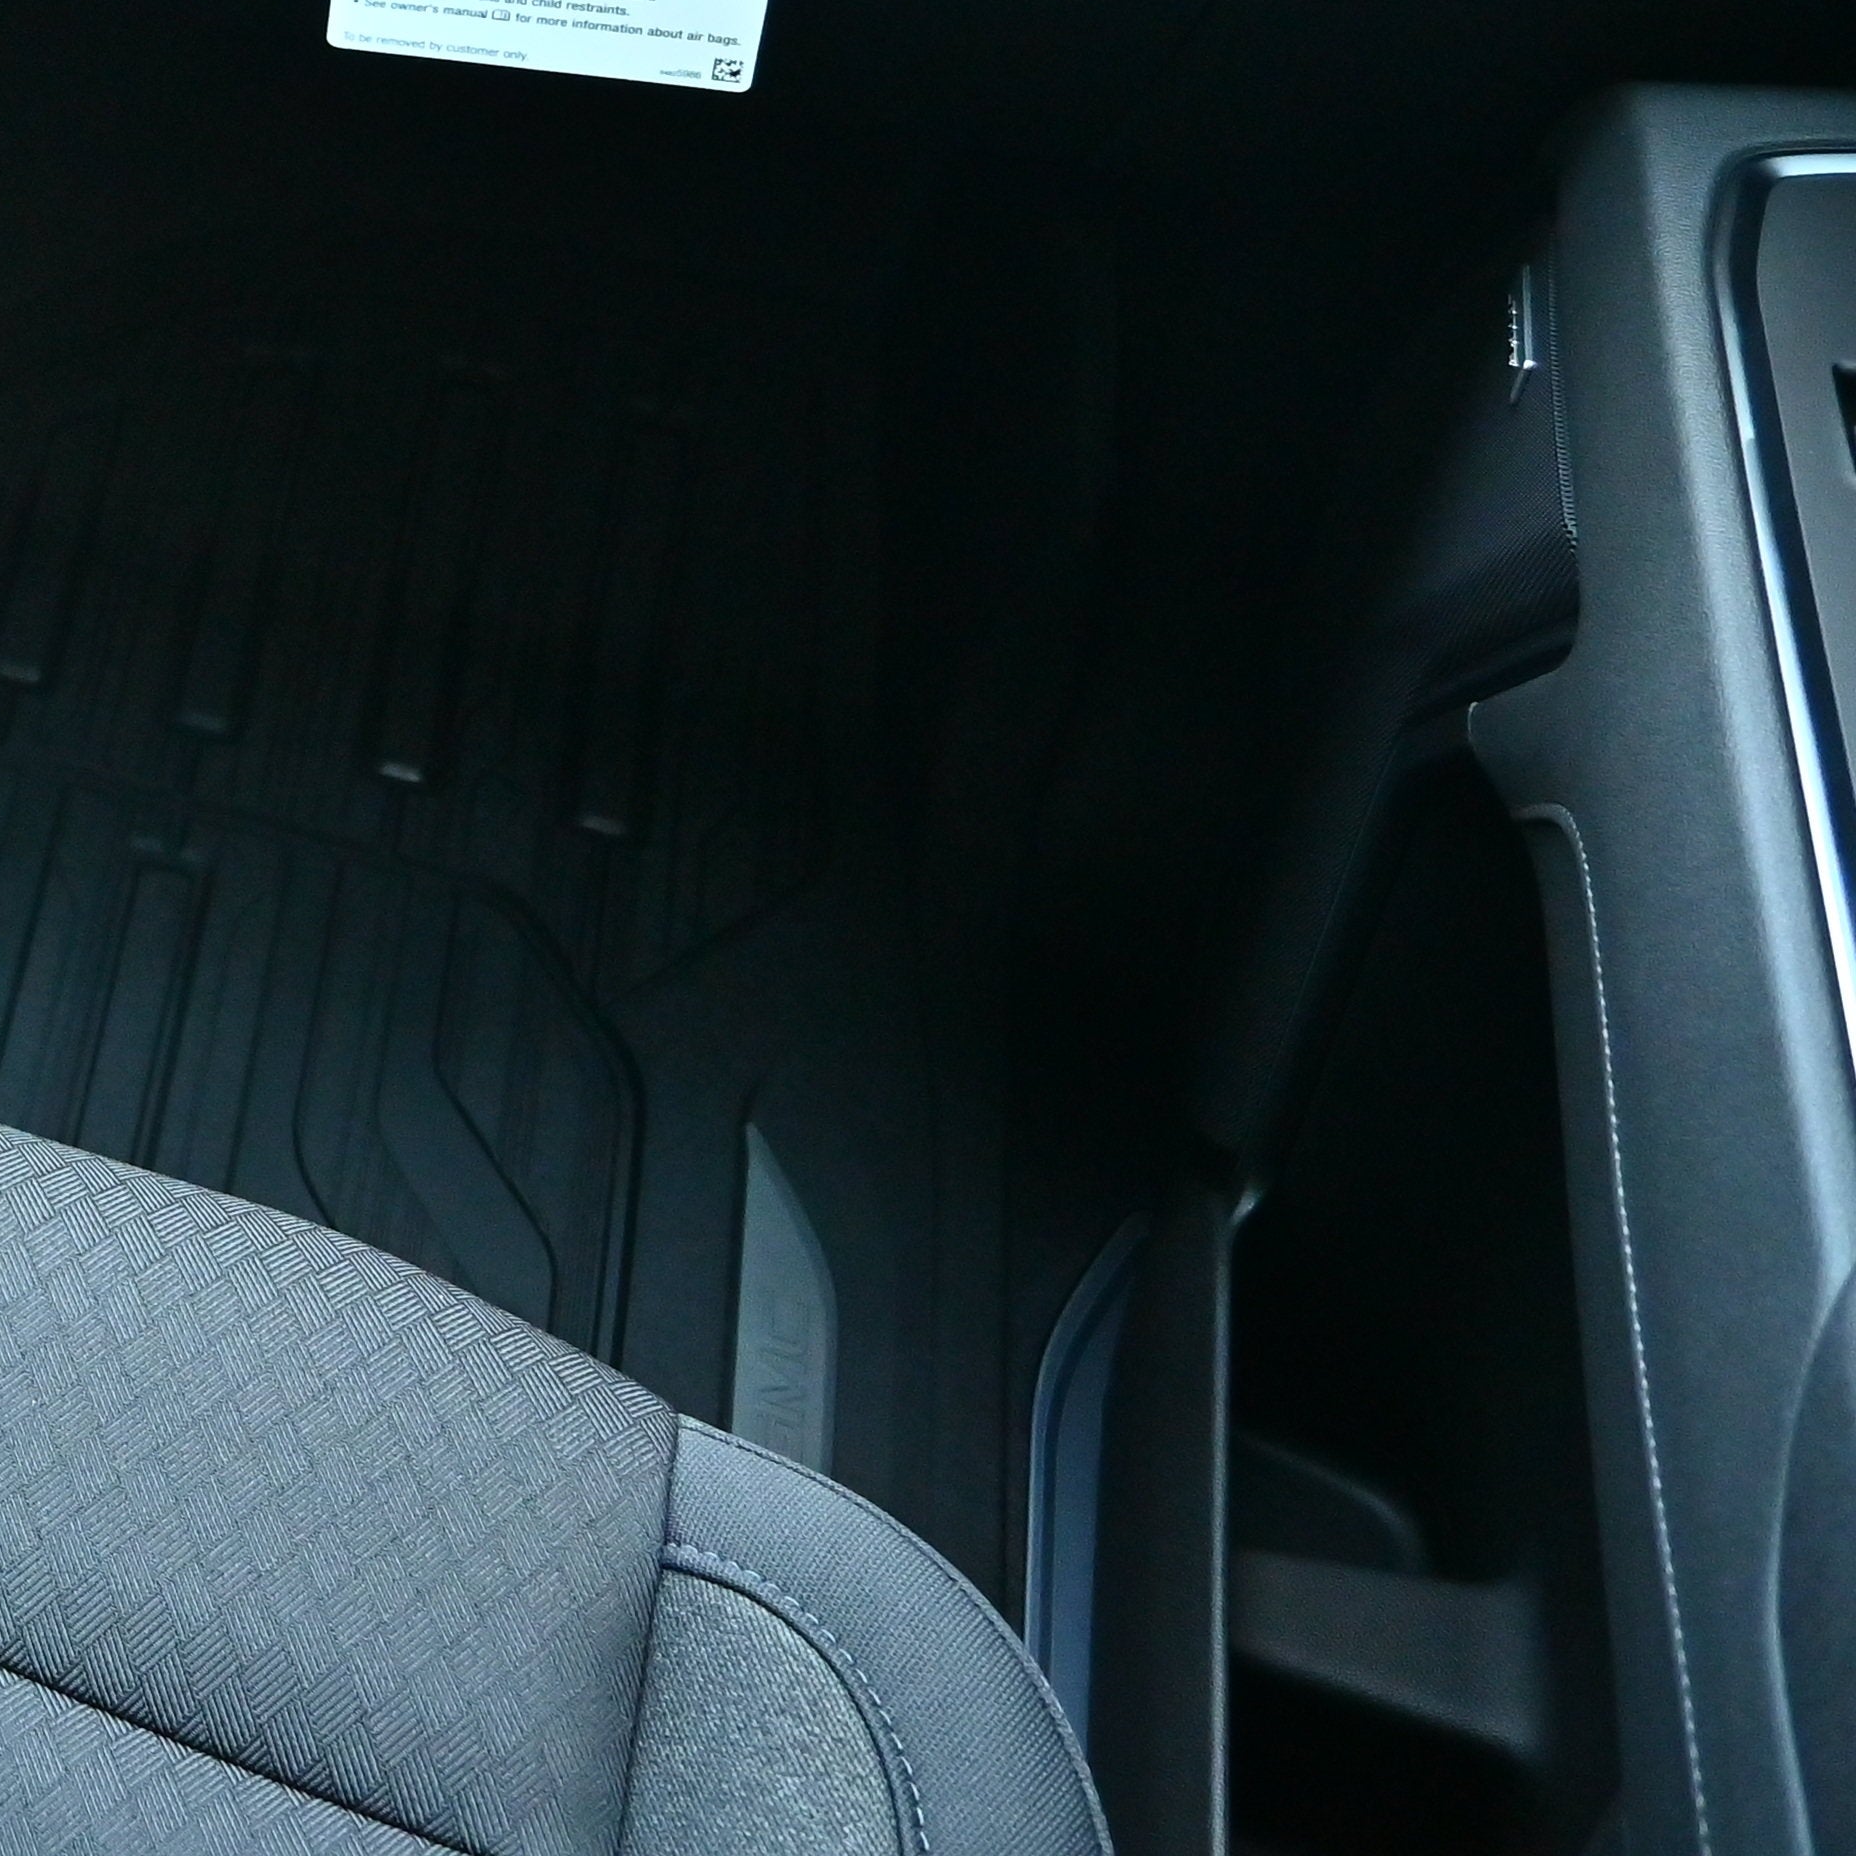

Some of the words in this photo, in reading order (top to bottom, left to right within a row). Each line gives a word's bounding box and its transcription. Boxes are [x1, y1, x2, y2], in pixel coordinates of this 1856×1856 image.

[566, 1, 630, 17] restraints.
[390, 1, 439, 14] owner's
[443, 6, 488, 19] manual
[515, 12, 531, 23] for
[536, 16, 568, 28] more
[572, 19, 643, 35] information
[647, 28, 683, 40] about
[687, 32, 704, 42] air
[707, 33, 742, 47] bags.
[359, 33, 372, 44] be
[376, 36, 426, 49] removed
[429, 41, 442, 53] by
[446, 44, 499, 57] customer
